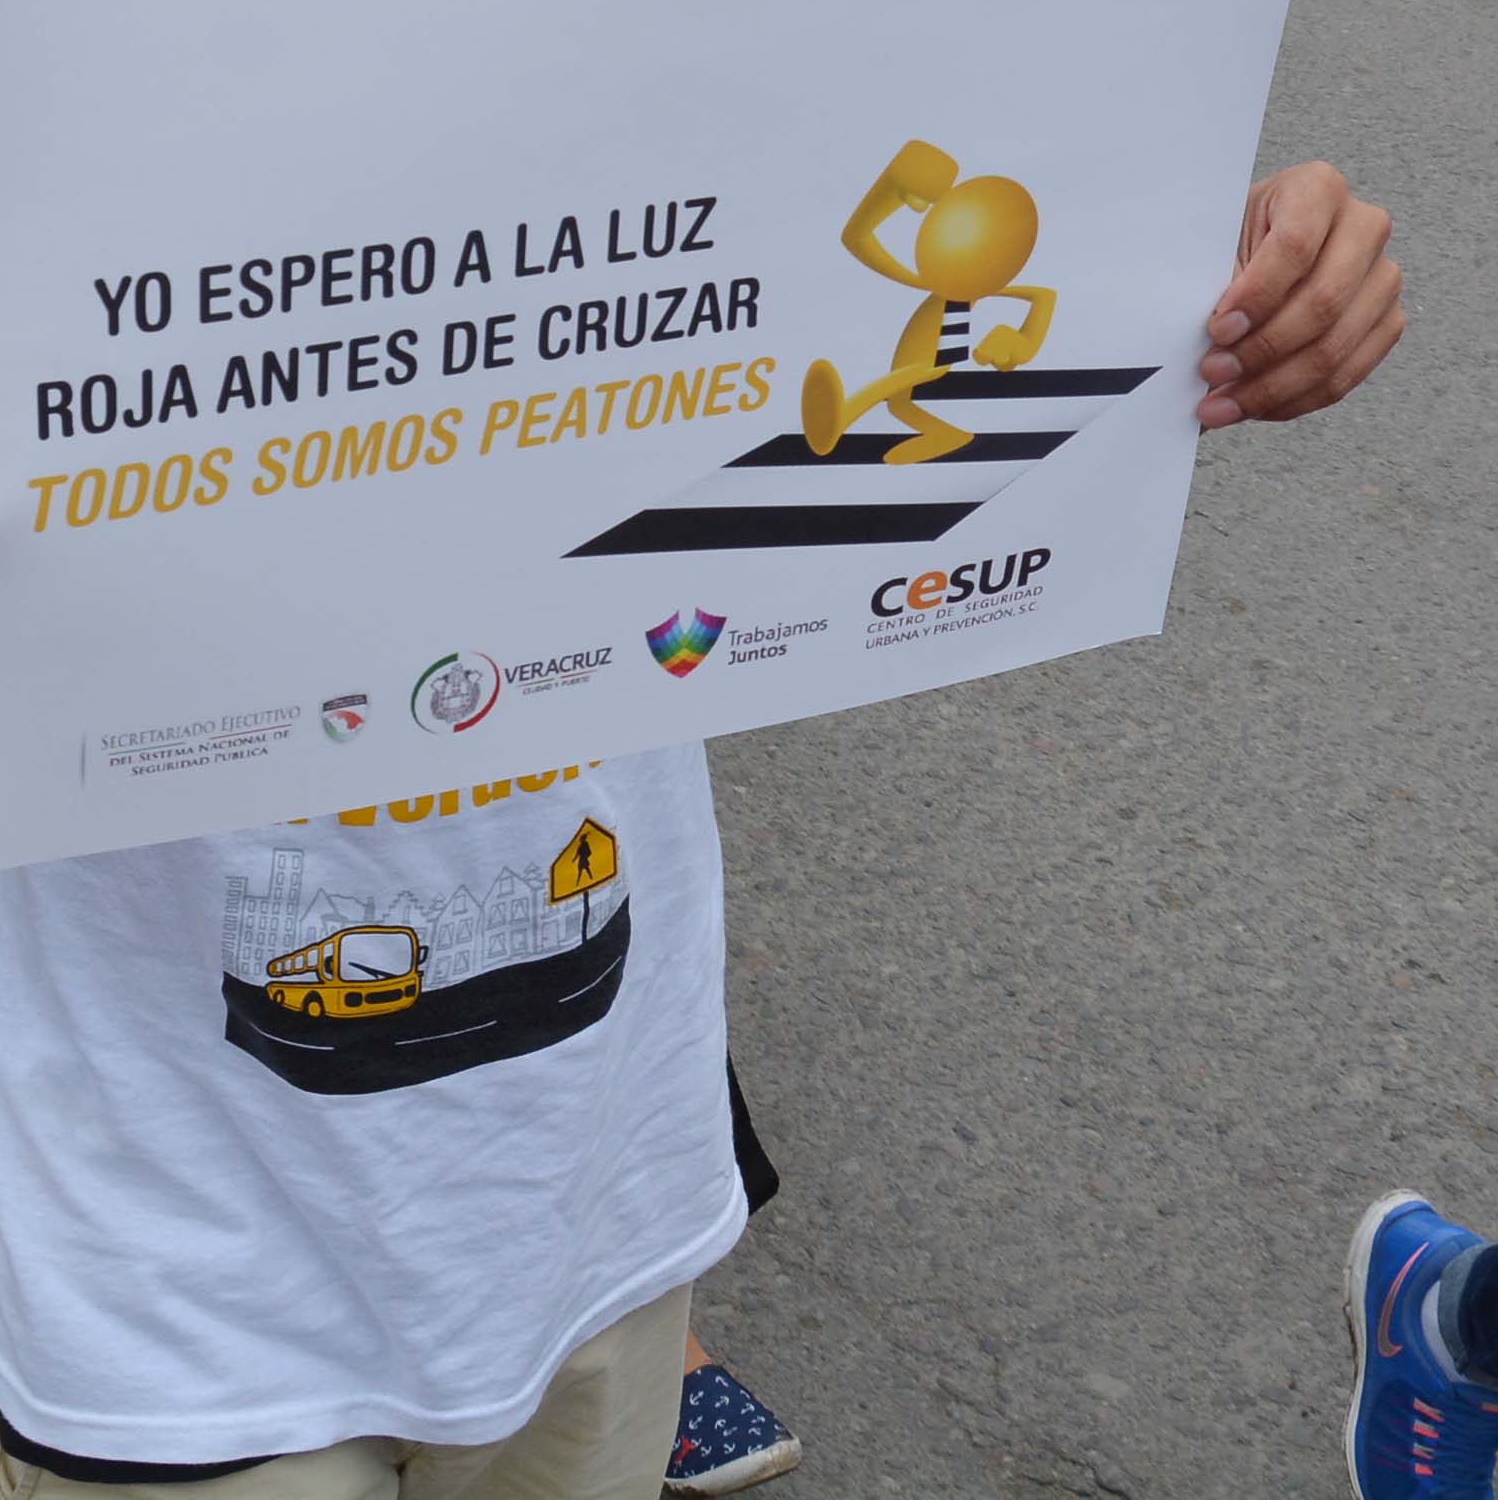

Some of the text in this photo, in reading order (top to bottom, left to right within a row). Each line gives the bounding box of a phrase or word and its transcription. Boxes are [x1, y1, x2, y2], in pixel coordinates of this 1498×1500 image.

[94, 196, 717, 336] YO ESPERO A LA LUZ
[36, 275, 761, 441] ROJA ANTES DE CRUZAR
[27, 356, 776, 533] TODOS SOMOS PEATONES
[870, 548, 1051, 618] CeSUP
[728, 617, 829, 648] Trabajamos
[865, 629, 920, 650] URBANA
[922, 626, 931, 637] Y
[1019, 602, 1040, 615] S.C.
[867, 586, 1043, 634] CENTRO DE SEGURIDAD
[504, 647, 612, 685] VERACRUZ
[728, 644, 787, 666] Juntos
[101, 705, 301, 750] SECRETARIADO EJECUTIVO
[109, 729, 289, 767] DEL SISTEMA NACIONAL DE
[131, 757, 209, 776] SEGURIDAD
